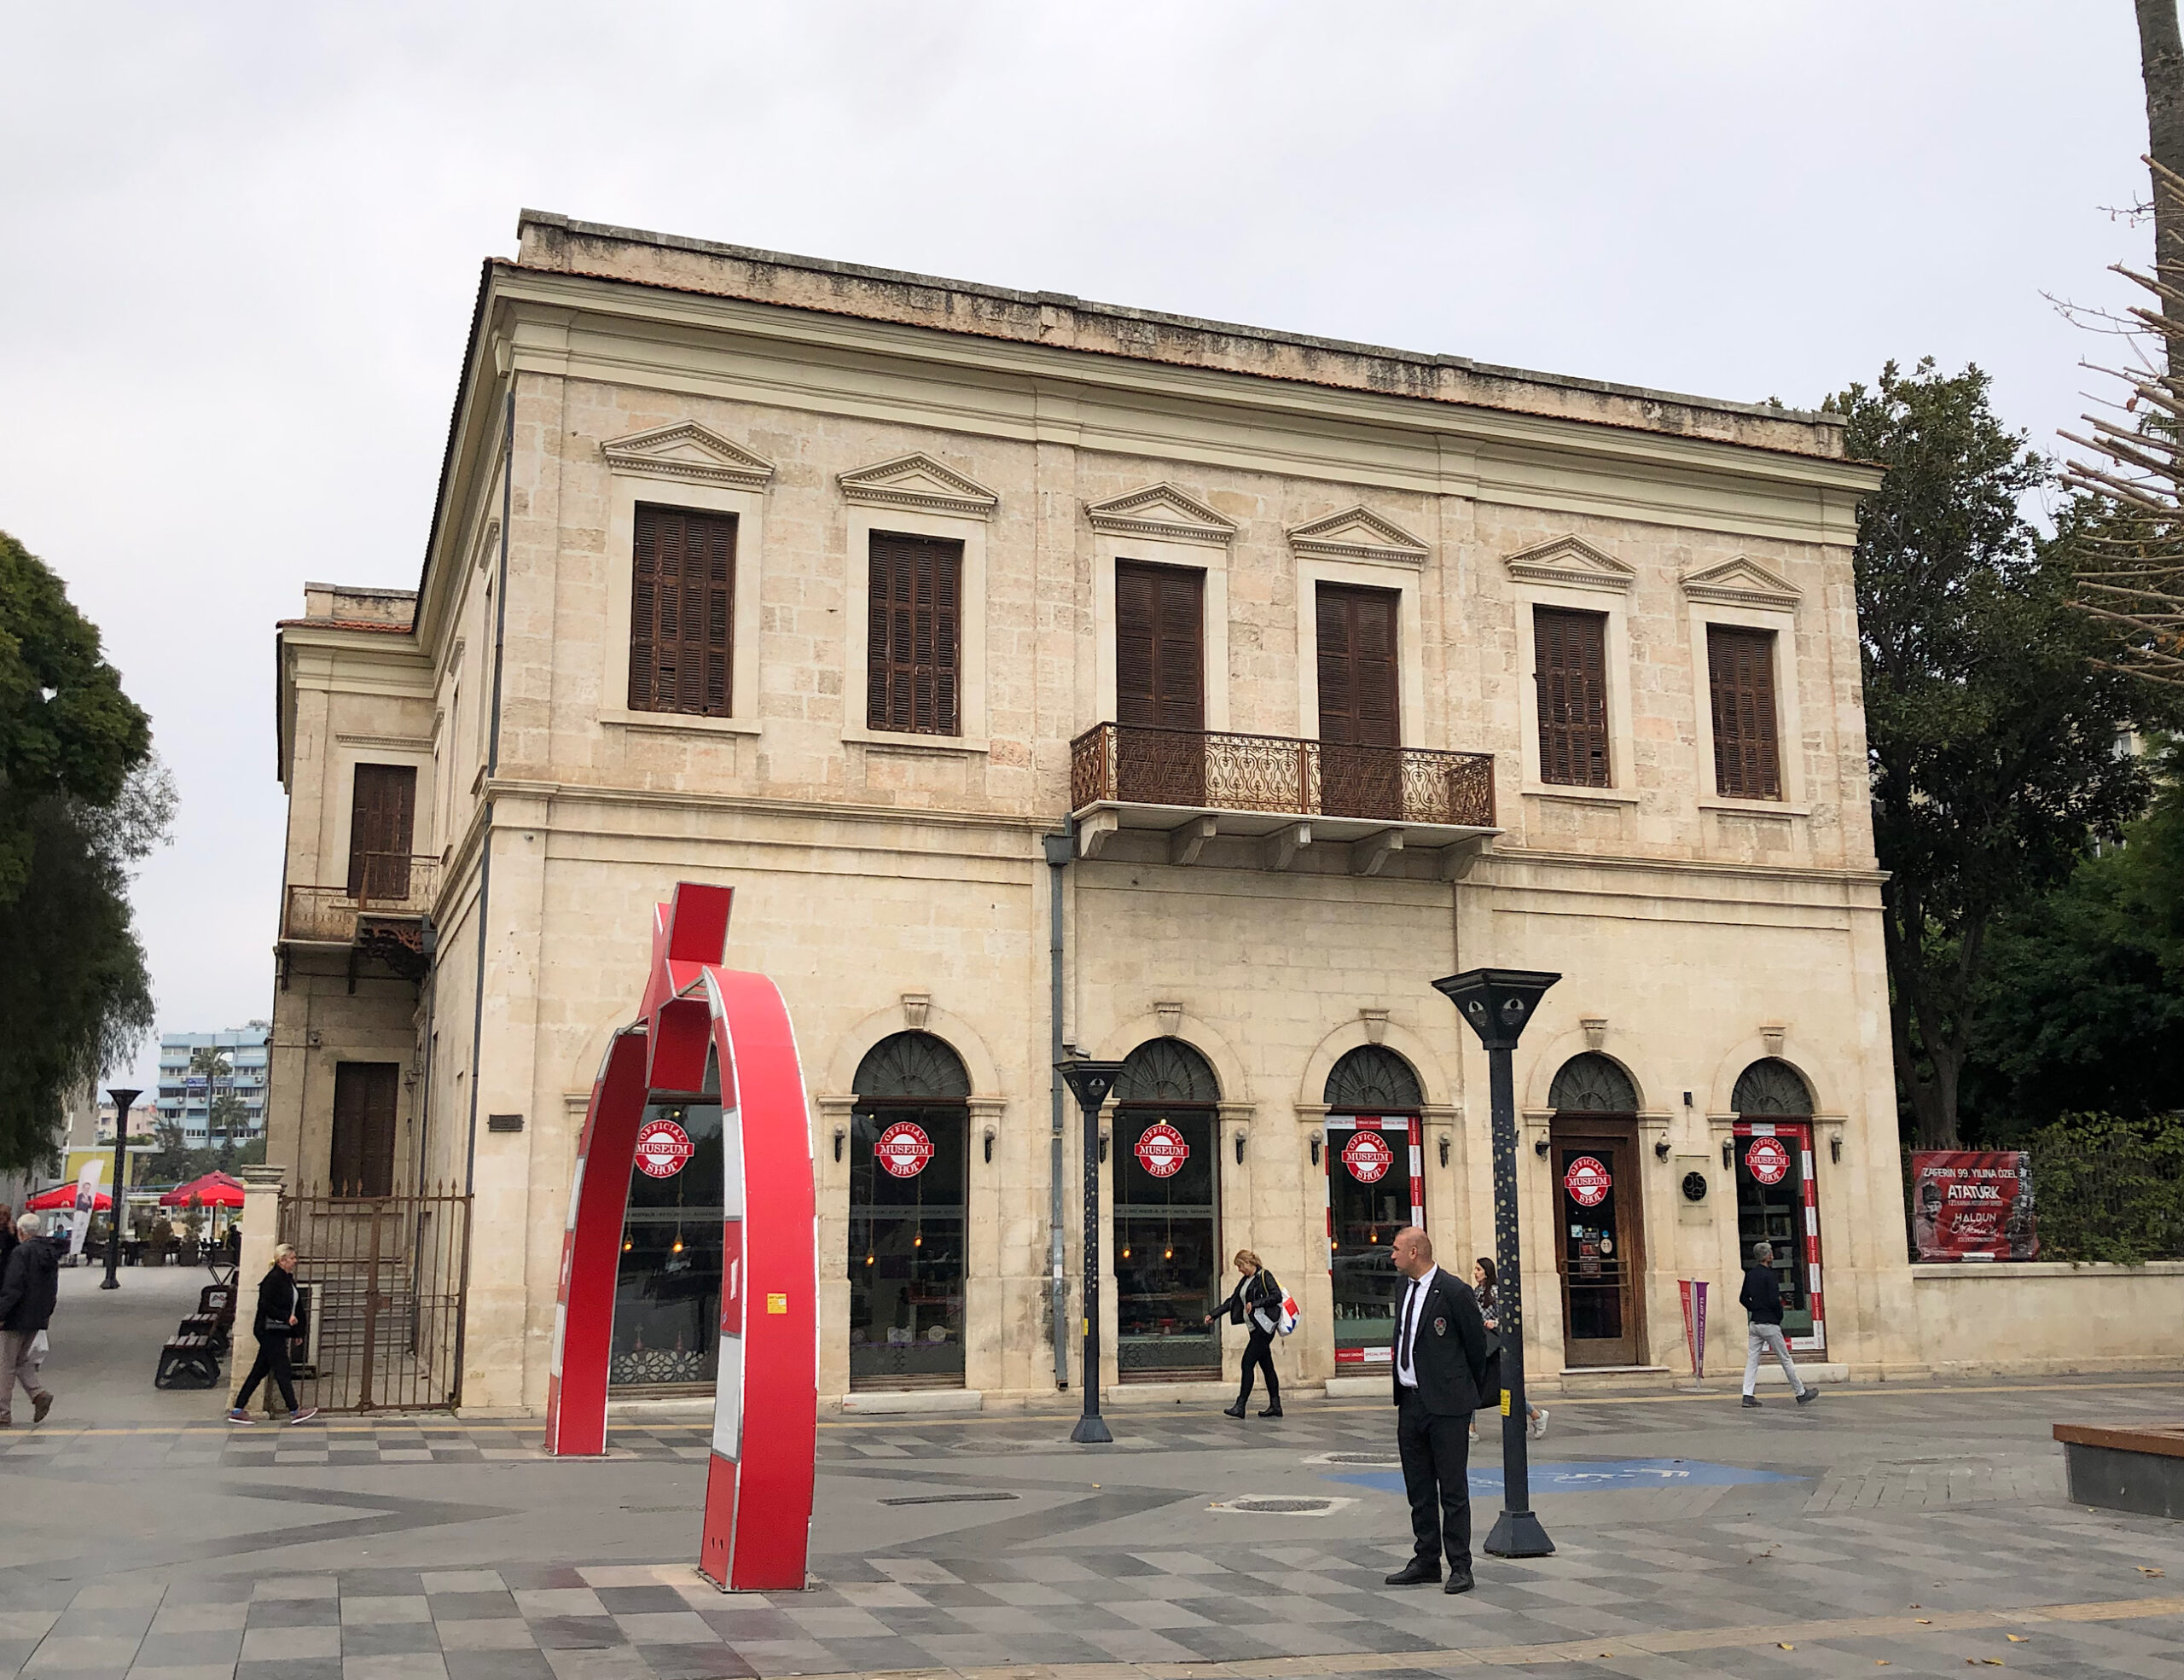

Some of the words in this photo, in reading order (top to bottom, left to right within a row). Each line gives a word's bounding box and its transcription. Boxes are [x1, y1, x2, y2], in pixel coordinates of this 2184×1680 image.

[640, 1122, 684, 1142] OFFICIAL
[884, 1124, 926, 1142] OFFICIAL
[1143, 1126, 1181, 1144] OFFICIAL
[1349, 1134, 1385, 1150] OFFICIAL
[1751, 1139, 1784, 1154] OFFICIAL
[880, 1144, 929, 1154] MUSEUM
[1139, 1145, 1185, 1155] MUSEUM
[1346, 1152, 1389, 1161] MUSEUM
[1749, 1155, 1786, 1165] MUSEUM
[646, 1161, 678, 1175] SHOP
[891, 1161, 921, 1175] SHOP
[1149, 1162, 1177, 1175] SHOP
[1571, 1159, 1604, 1175] OFFICIAL
[1957, 1168, 1971, 1178] 99.
[1972, 1168, 1998, 1178] YILINA
[1998, 1166, 2018, 1178] ÖZEL
[1356, 1167, 1382, 1181] SHOP
[1758, 1170, 1780, 1183] SHOP
[1568, 1177, 1608, 1187] MUSEUM
[1578, 1191, 1602, 1204] SHOP
[1948, 1182, 2001, 1200] ATATÜRK
[1955, 1212, 1997, 1223] HALDUN
